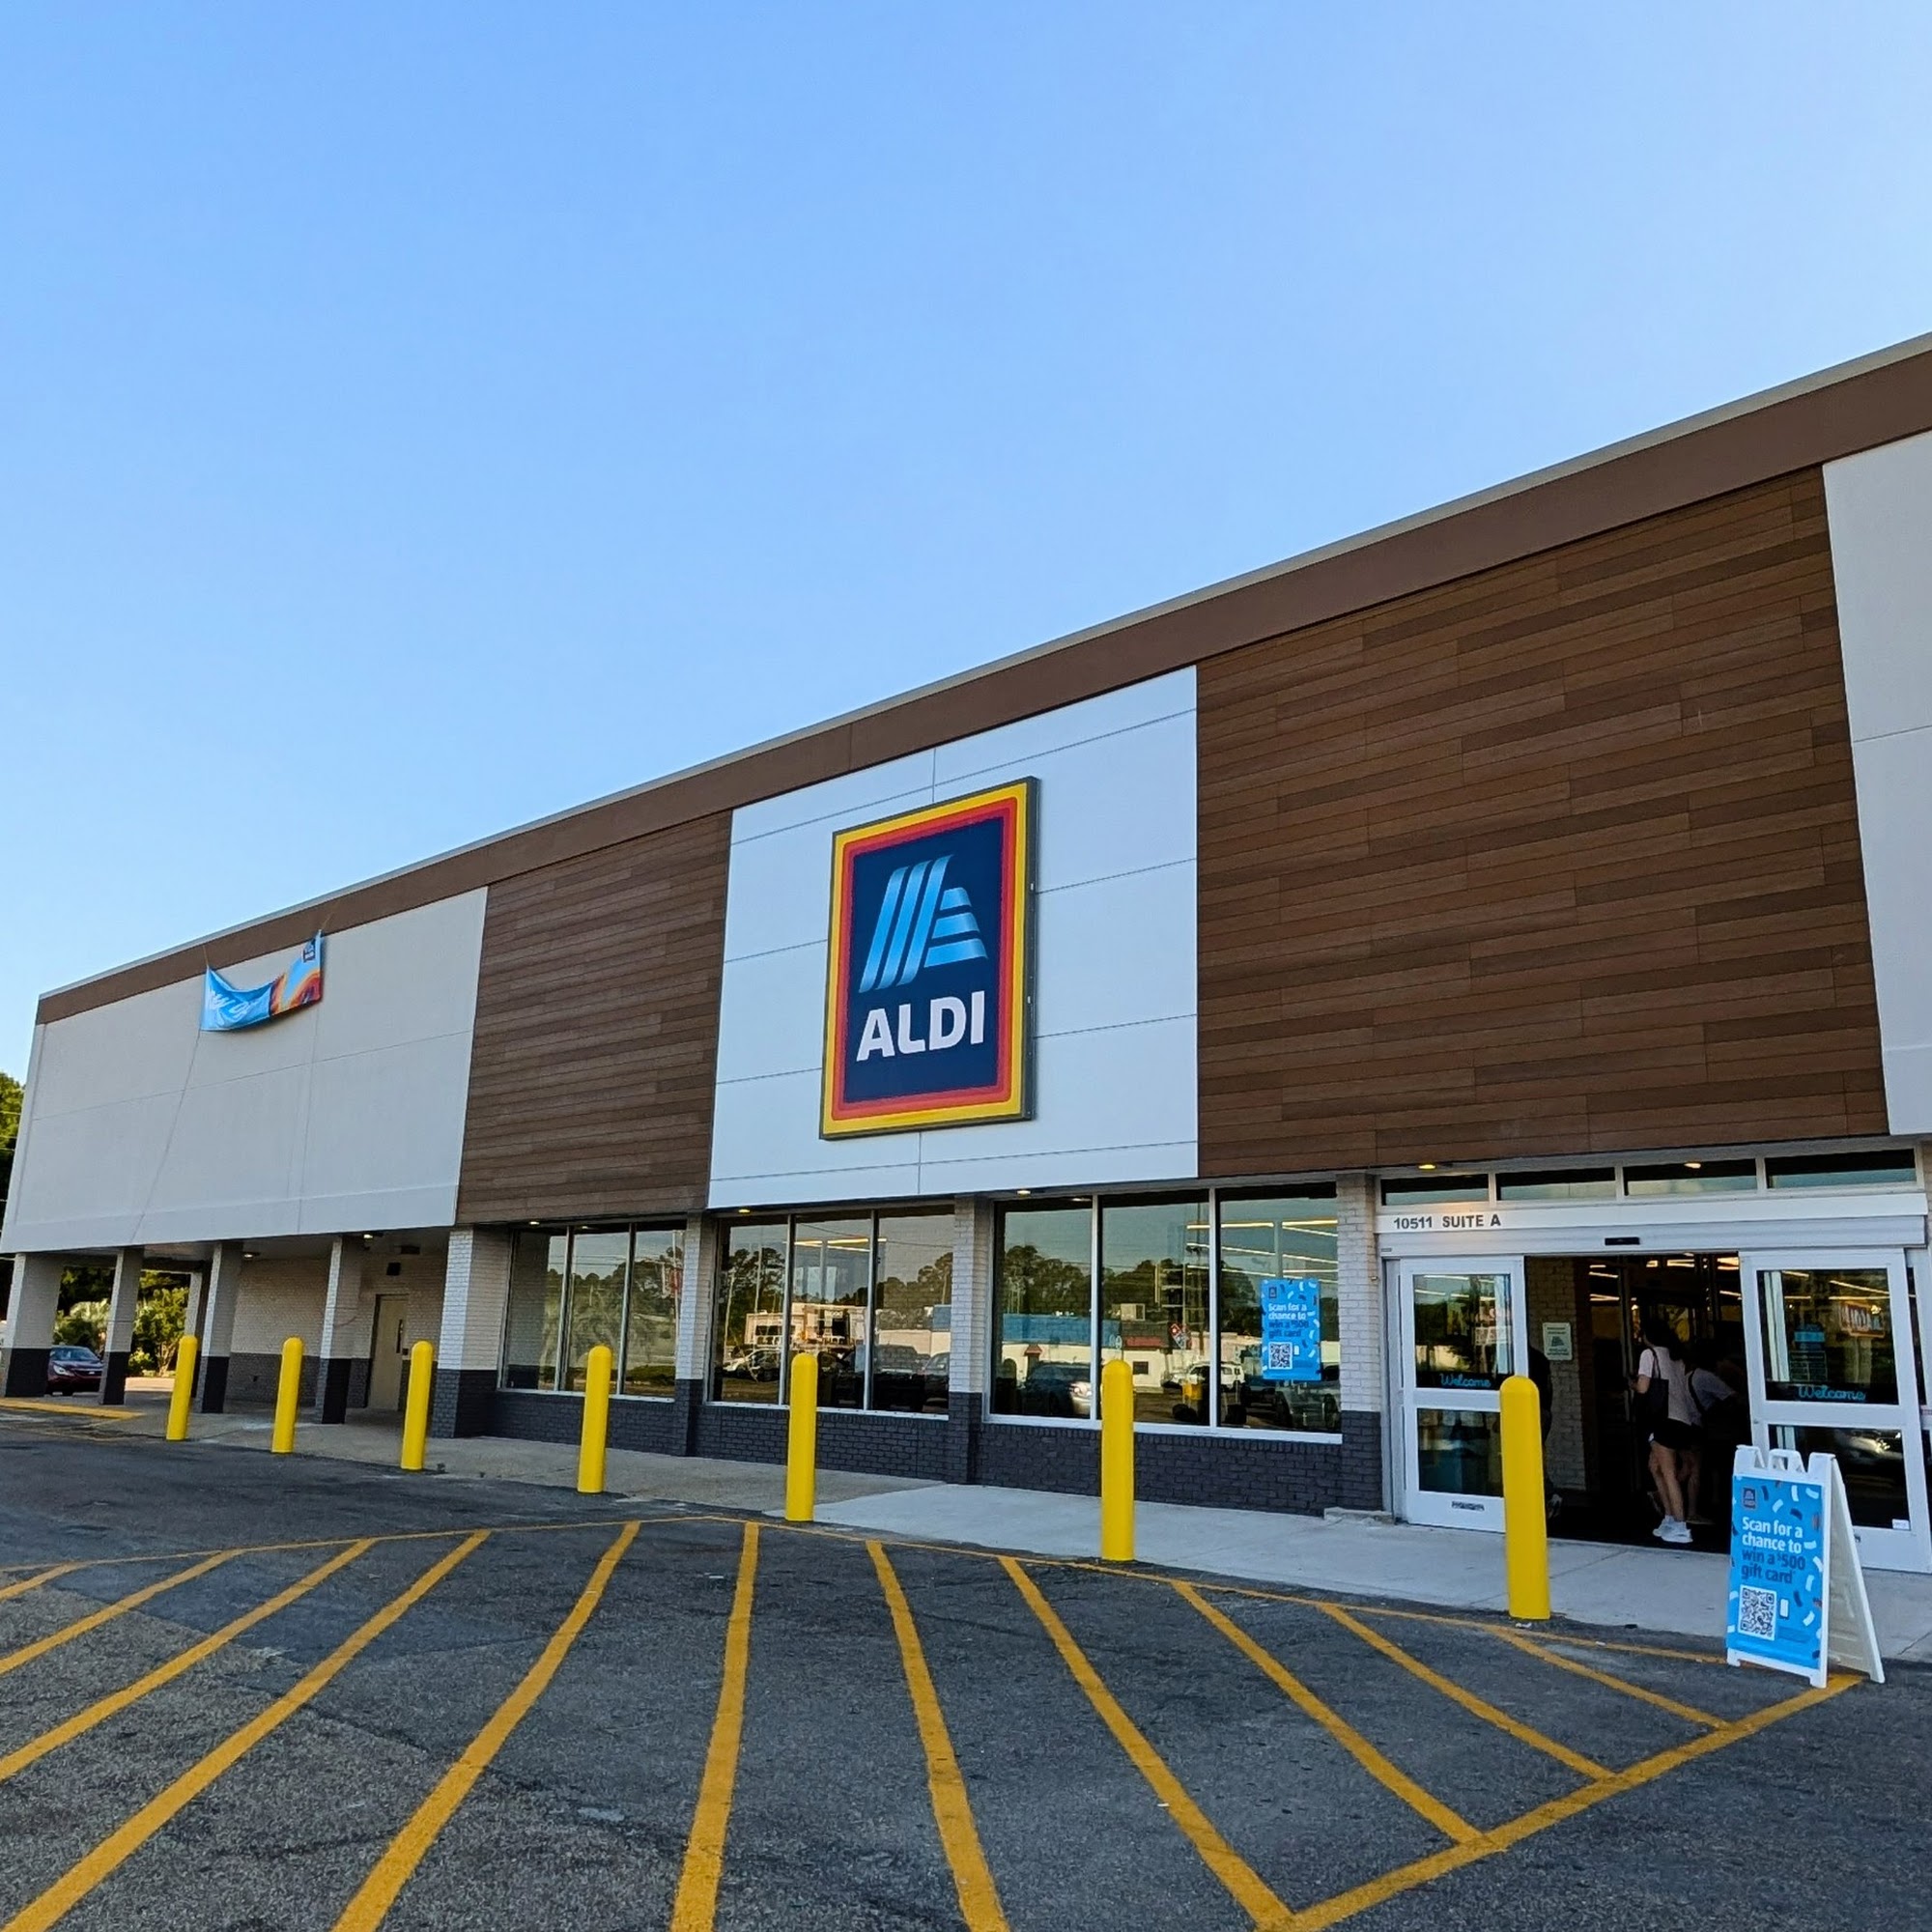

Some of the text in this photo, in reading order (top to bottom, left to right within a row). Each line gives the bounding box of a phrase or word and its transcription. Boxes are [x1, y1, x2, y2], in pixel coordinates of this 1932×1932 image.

[856, 990, 985, 1062] ALDI
[1393, 1213, 1501, 1229] 10511 SUITE A
[1438, 1373, 1492, 1388] Welcome
[1798, 1384, 1866, 1401] Welcome
[1742, 1516, 1804, 1538] Scan for a
[1742, 1532, 1803, 1553] chance to
[1742, 1547, 1765, 1562] win
[1767, 1553, 1775, 1565] a
[1741, 1562, 1763, 1580] gift
